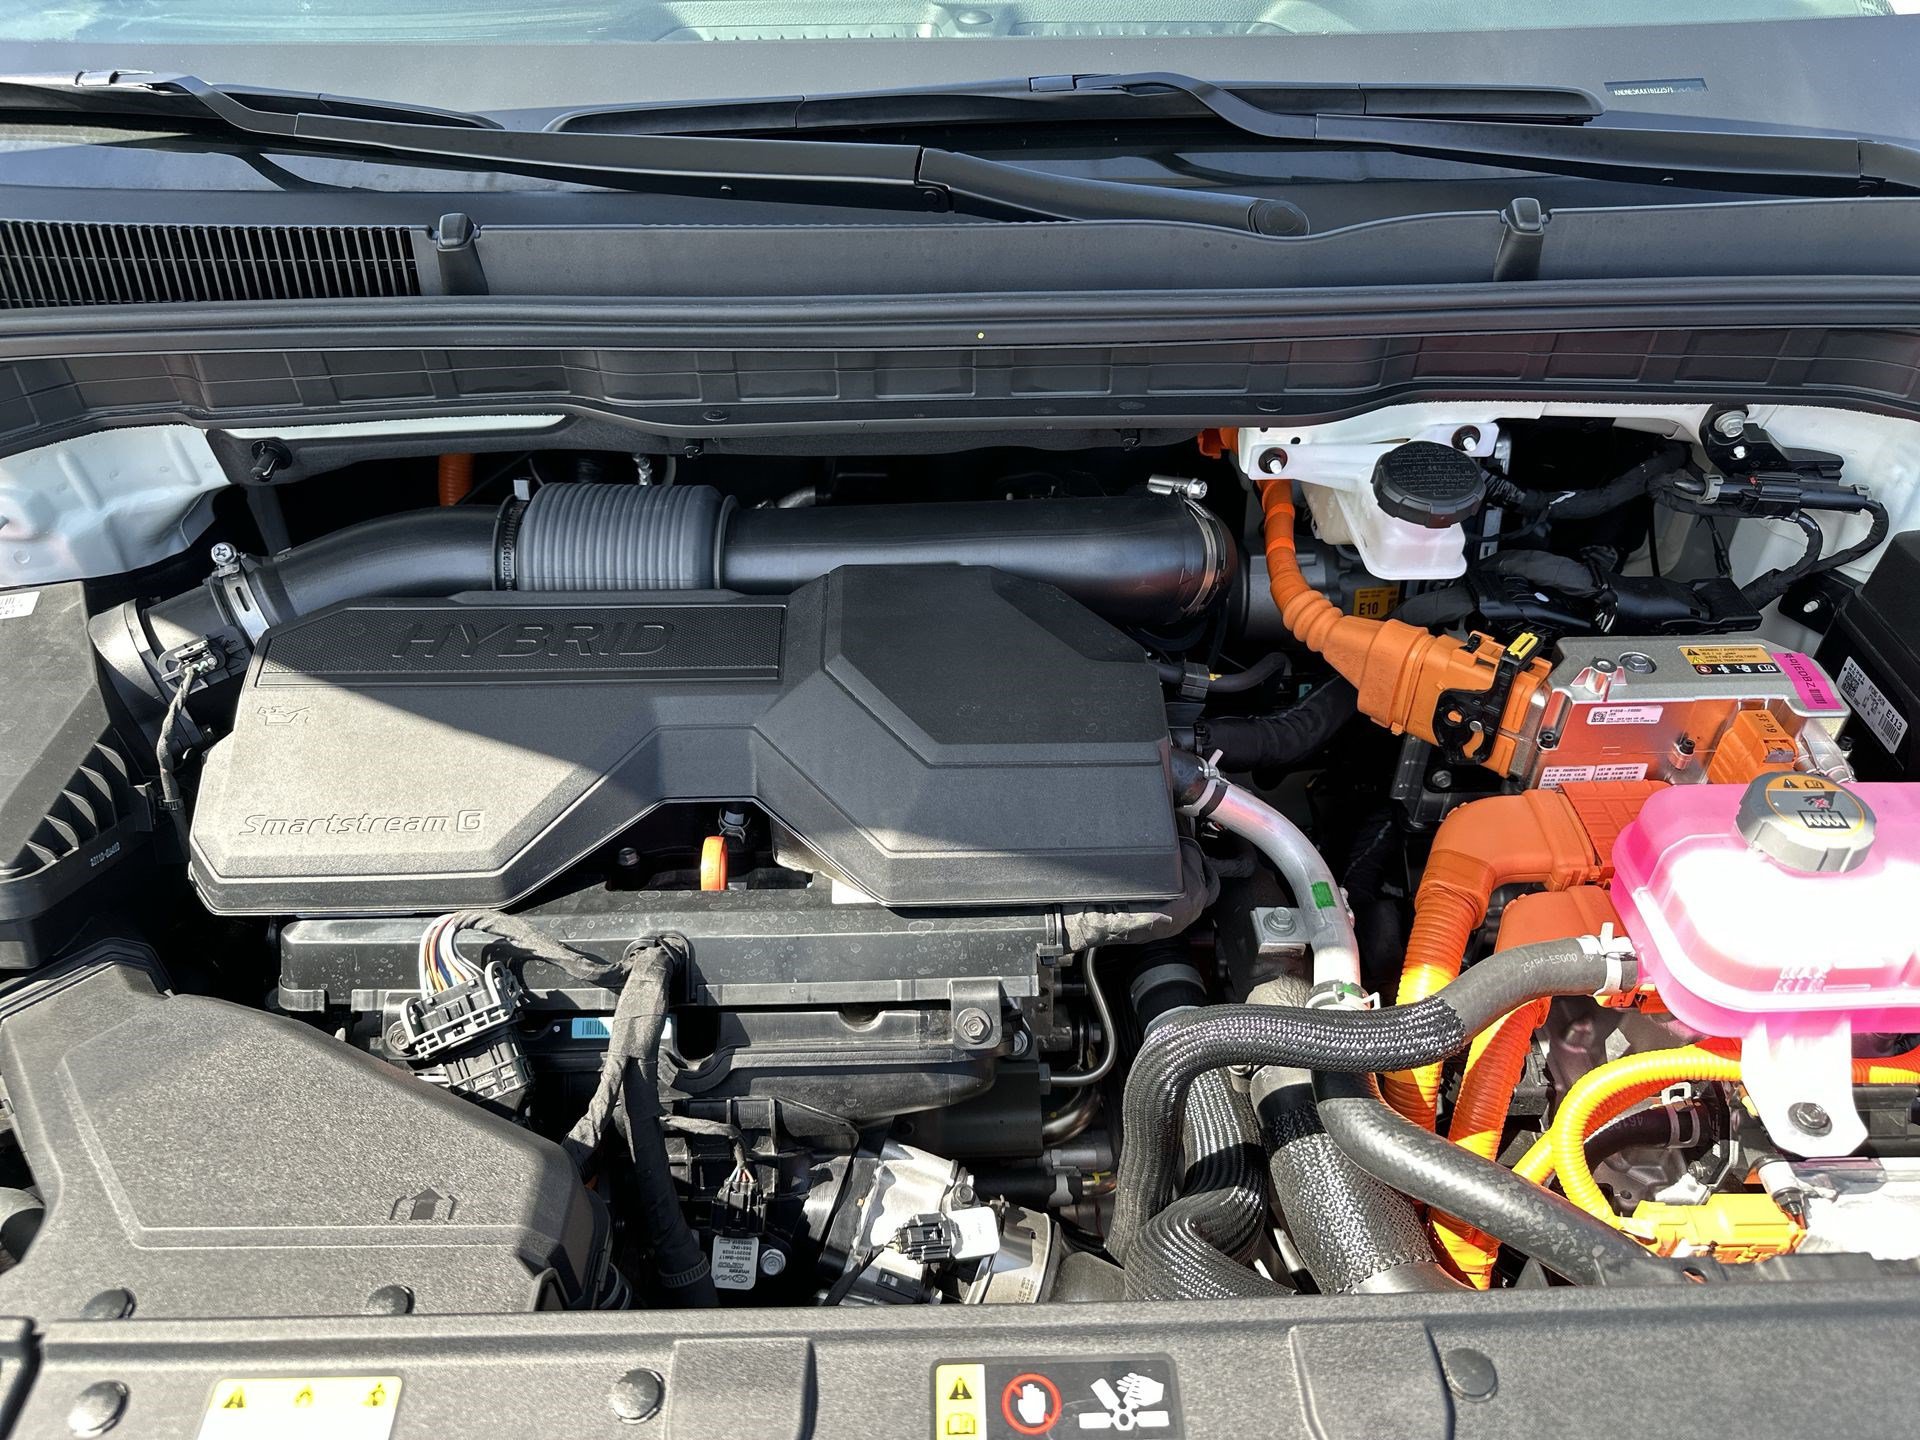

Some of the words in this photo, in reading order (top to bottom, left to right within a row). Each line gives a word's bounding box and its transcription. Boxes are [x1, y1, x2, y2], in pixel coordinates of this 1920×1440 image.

[1359, 602, 1379, 615] E10
[392, 623, 674, 657] HYBRID
[1885, 709, 1903, 731] E113
[239, 813, 450, 835] Smartstream
